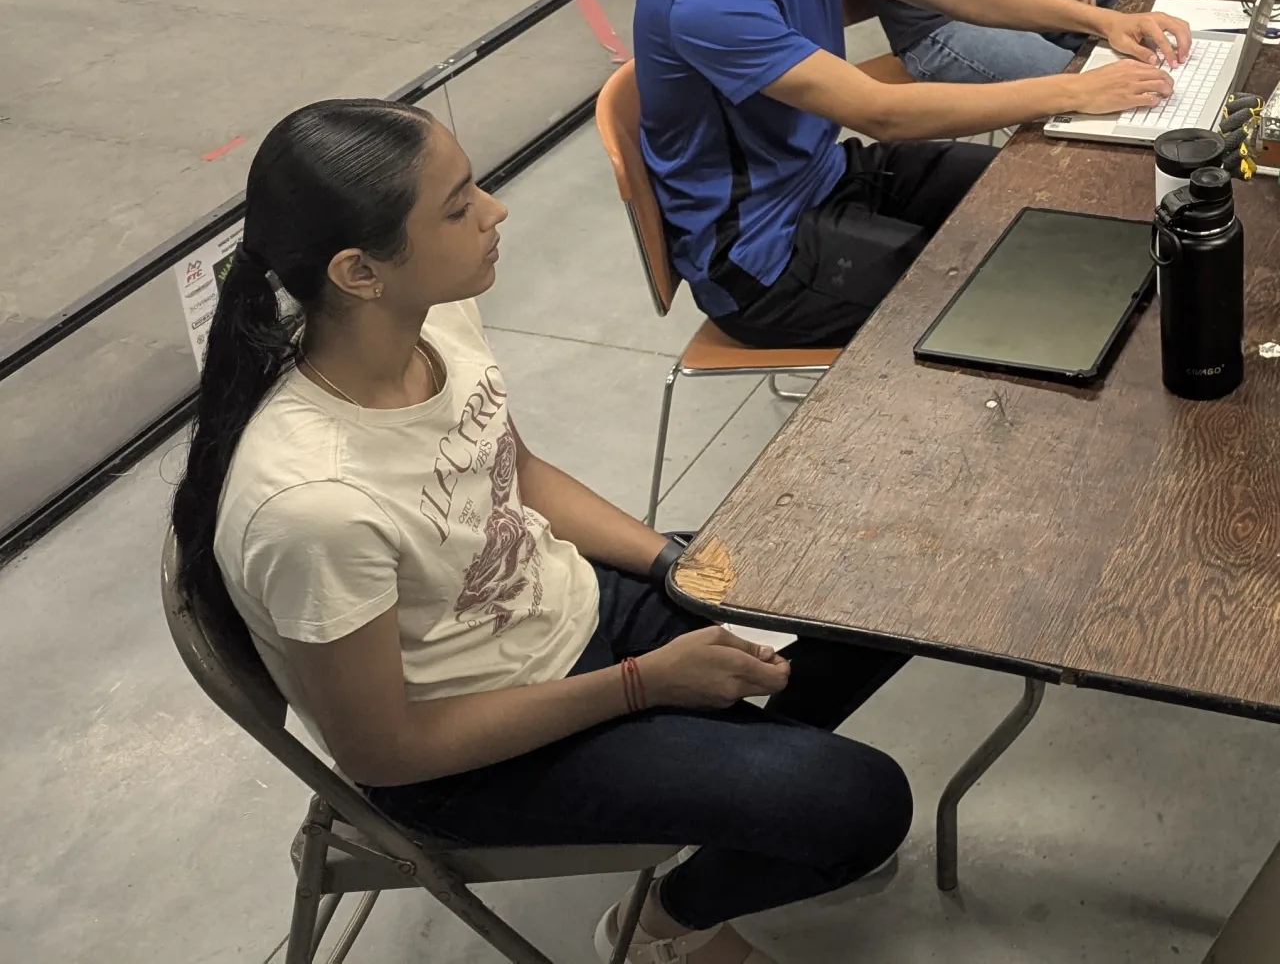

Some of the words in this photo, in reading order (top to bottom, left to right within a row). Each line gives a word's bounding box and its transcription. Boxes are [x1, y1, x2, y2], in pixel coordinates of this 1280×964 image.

[419, 365, 508, 547] ELECTRIC
[471, 438, 493, 475] VIBES
[458, 496, 475, 525] CATCH
